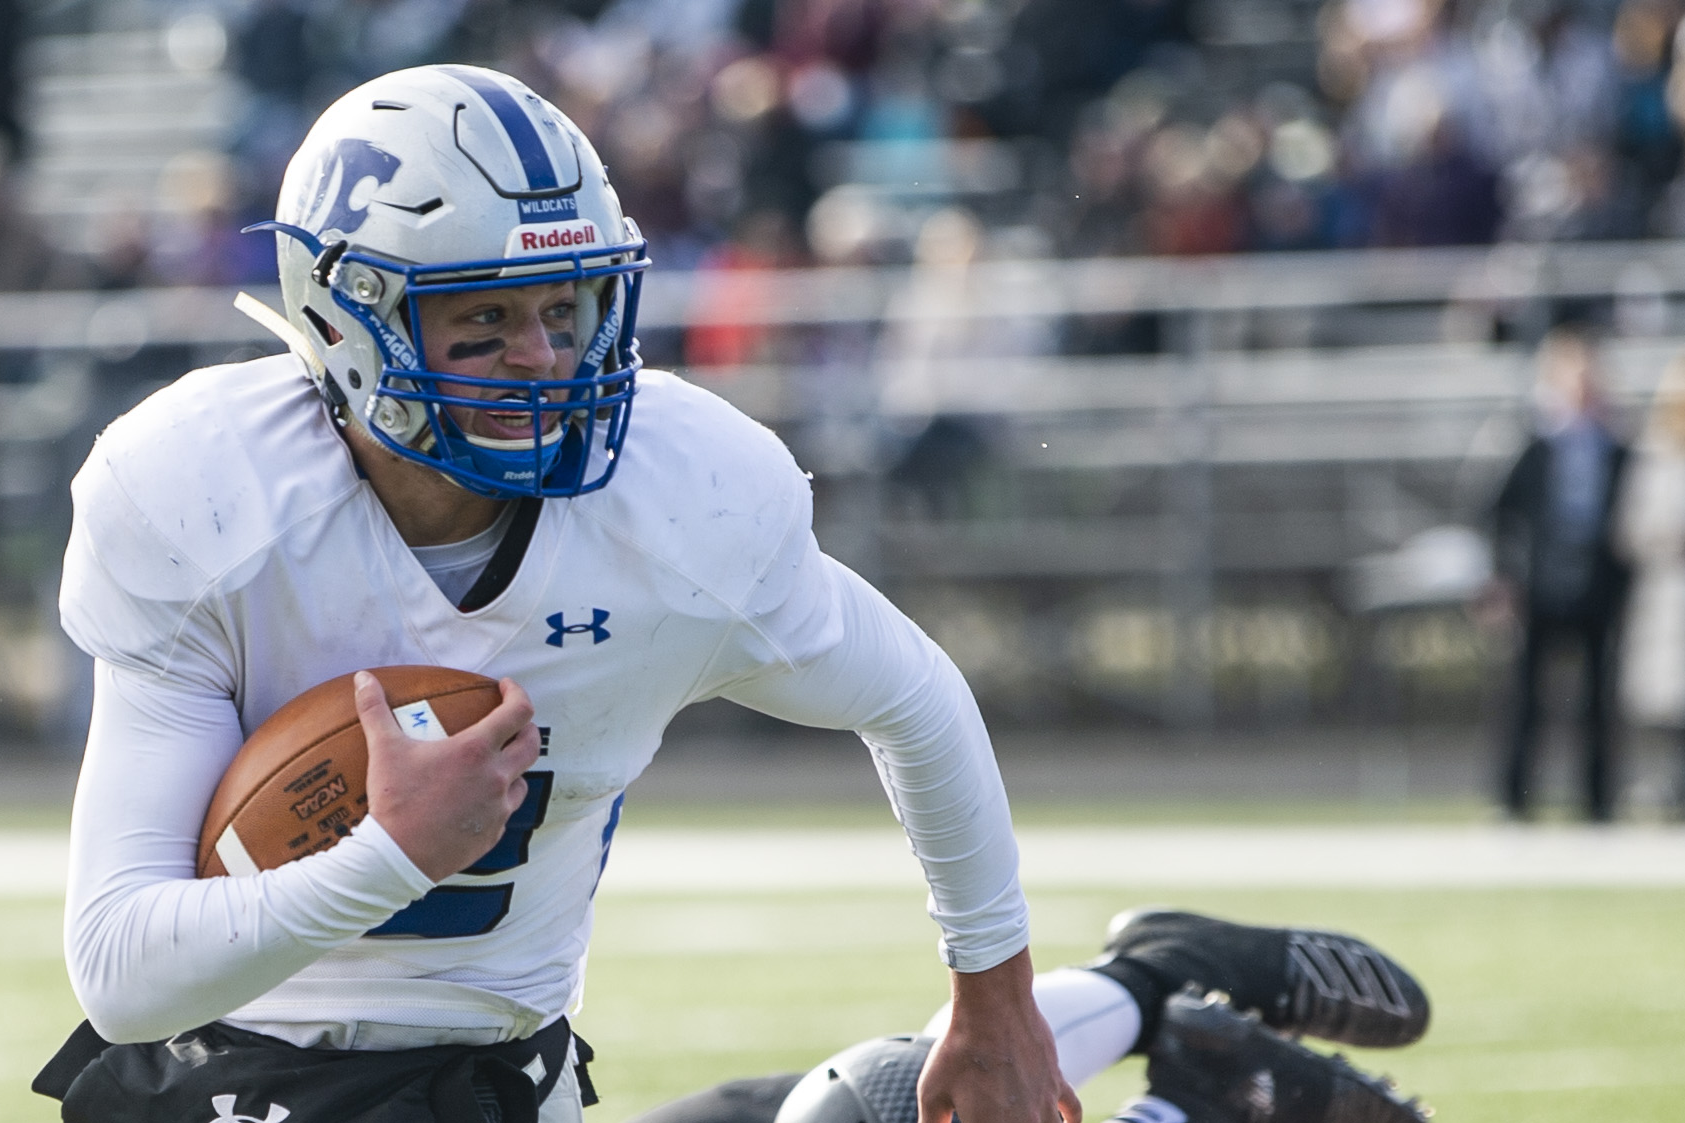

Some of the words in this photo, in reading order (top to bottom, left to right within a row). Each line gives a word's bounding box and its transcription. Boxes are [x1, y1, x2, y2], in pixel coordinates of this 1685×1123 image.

[520, 198, 576, 214] WILDCATS
[521, 225, 595, 250] Riddell
[290, 774, 347, 820] NCAA
